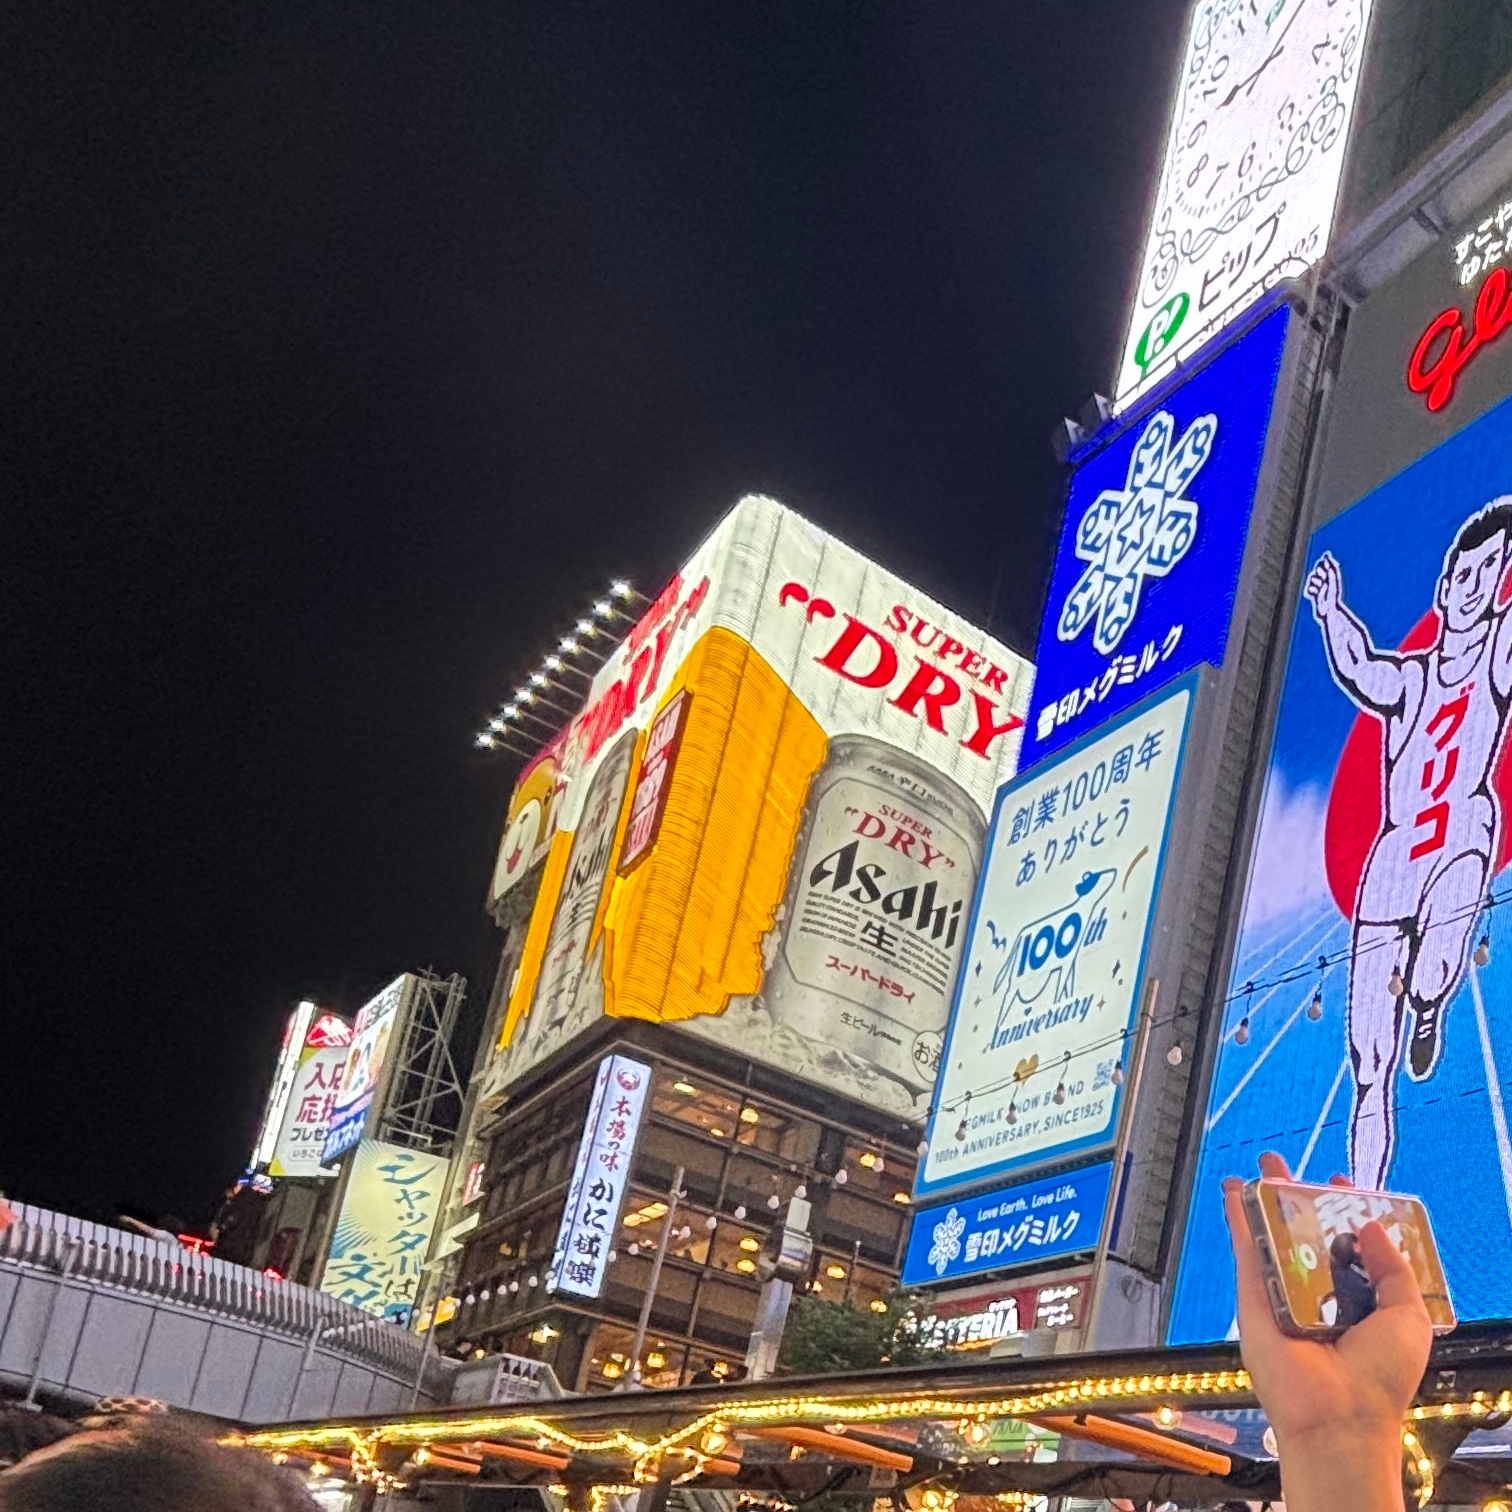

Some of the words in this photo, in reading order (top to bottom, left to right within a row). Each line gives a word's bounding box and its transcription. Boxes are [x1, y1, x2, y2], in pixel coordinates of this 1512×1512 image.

[1198, 201, 1287, 312] ピップ
[883, 604, 1009, 696] SUPER
[1036, 624, 1184, 741] 雪印メグミルク
[1007, 729, 1165, 847] 創業100周年
[1409, 680, 1476, 862] グリコ
[878, 804, 933, 840] SUPER
[1016, 798, 1131, 887] ありがとう
[809, 840, 963, 949] Asahi
[826, 955, 915, 1004] スーパードライ
[859, 921, 898, 957] 生
[982, 994, 1094, 1054] Anniversary
[600, 1096, 632, 1172] 本場の味
[964, 1210, 1080, 1263] 雪印メグミルク
[977, 1208, 999, 1222] Love
[1000, 1197, 1028, 1216] Earth.
[1031, 1193, 1054, 1208] Love
[1056, 1184, 1077, 1202] Life.
